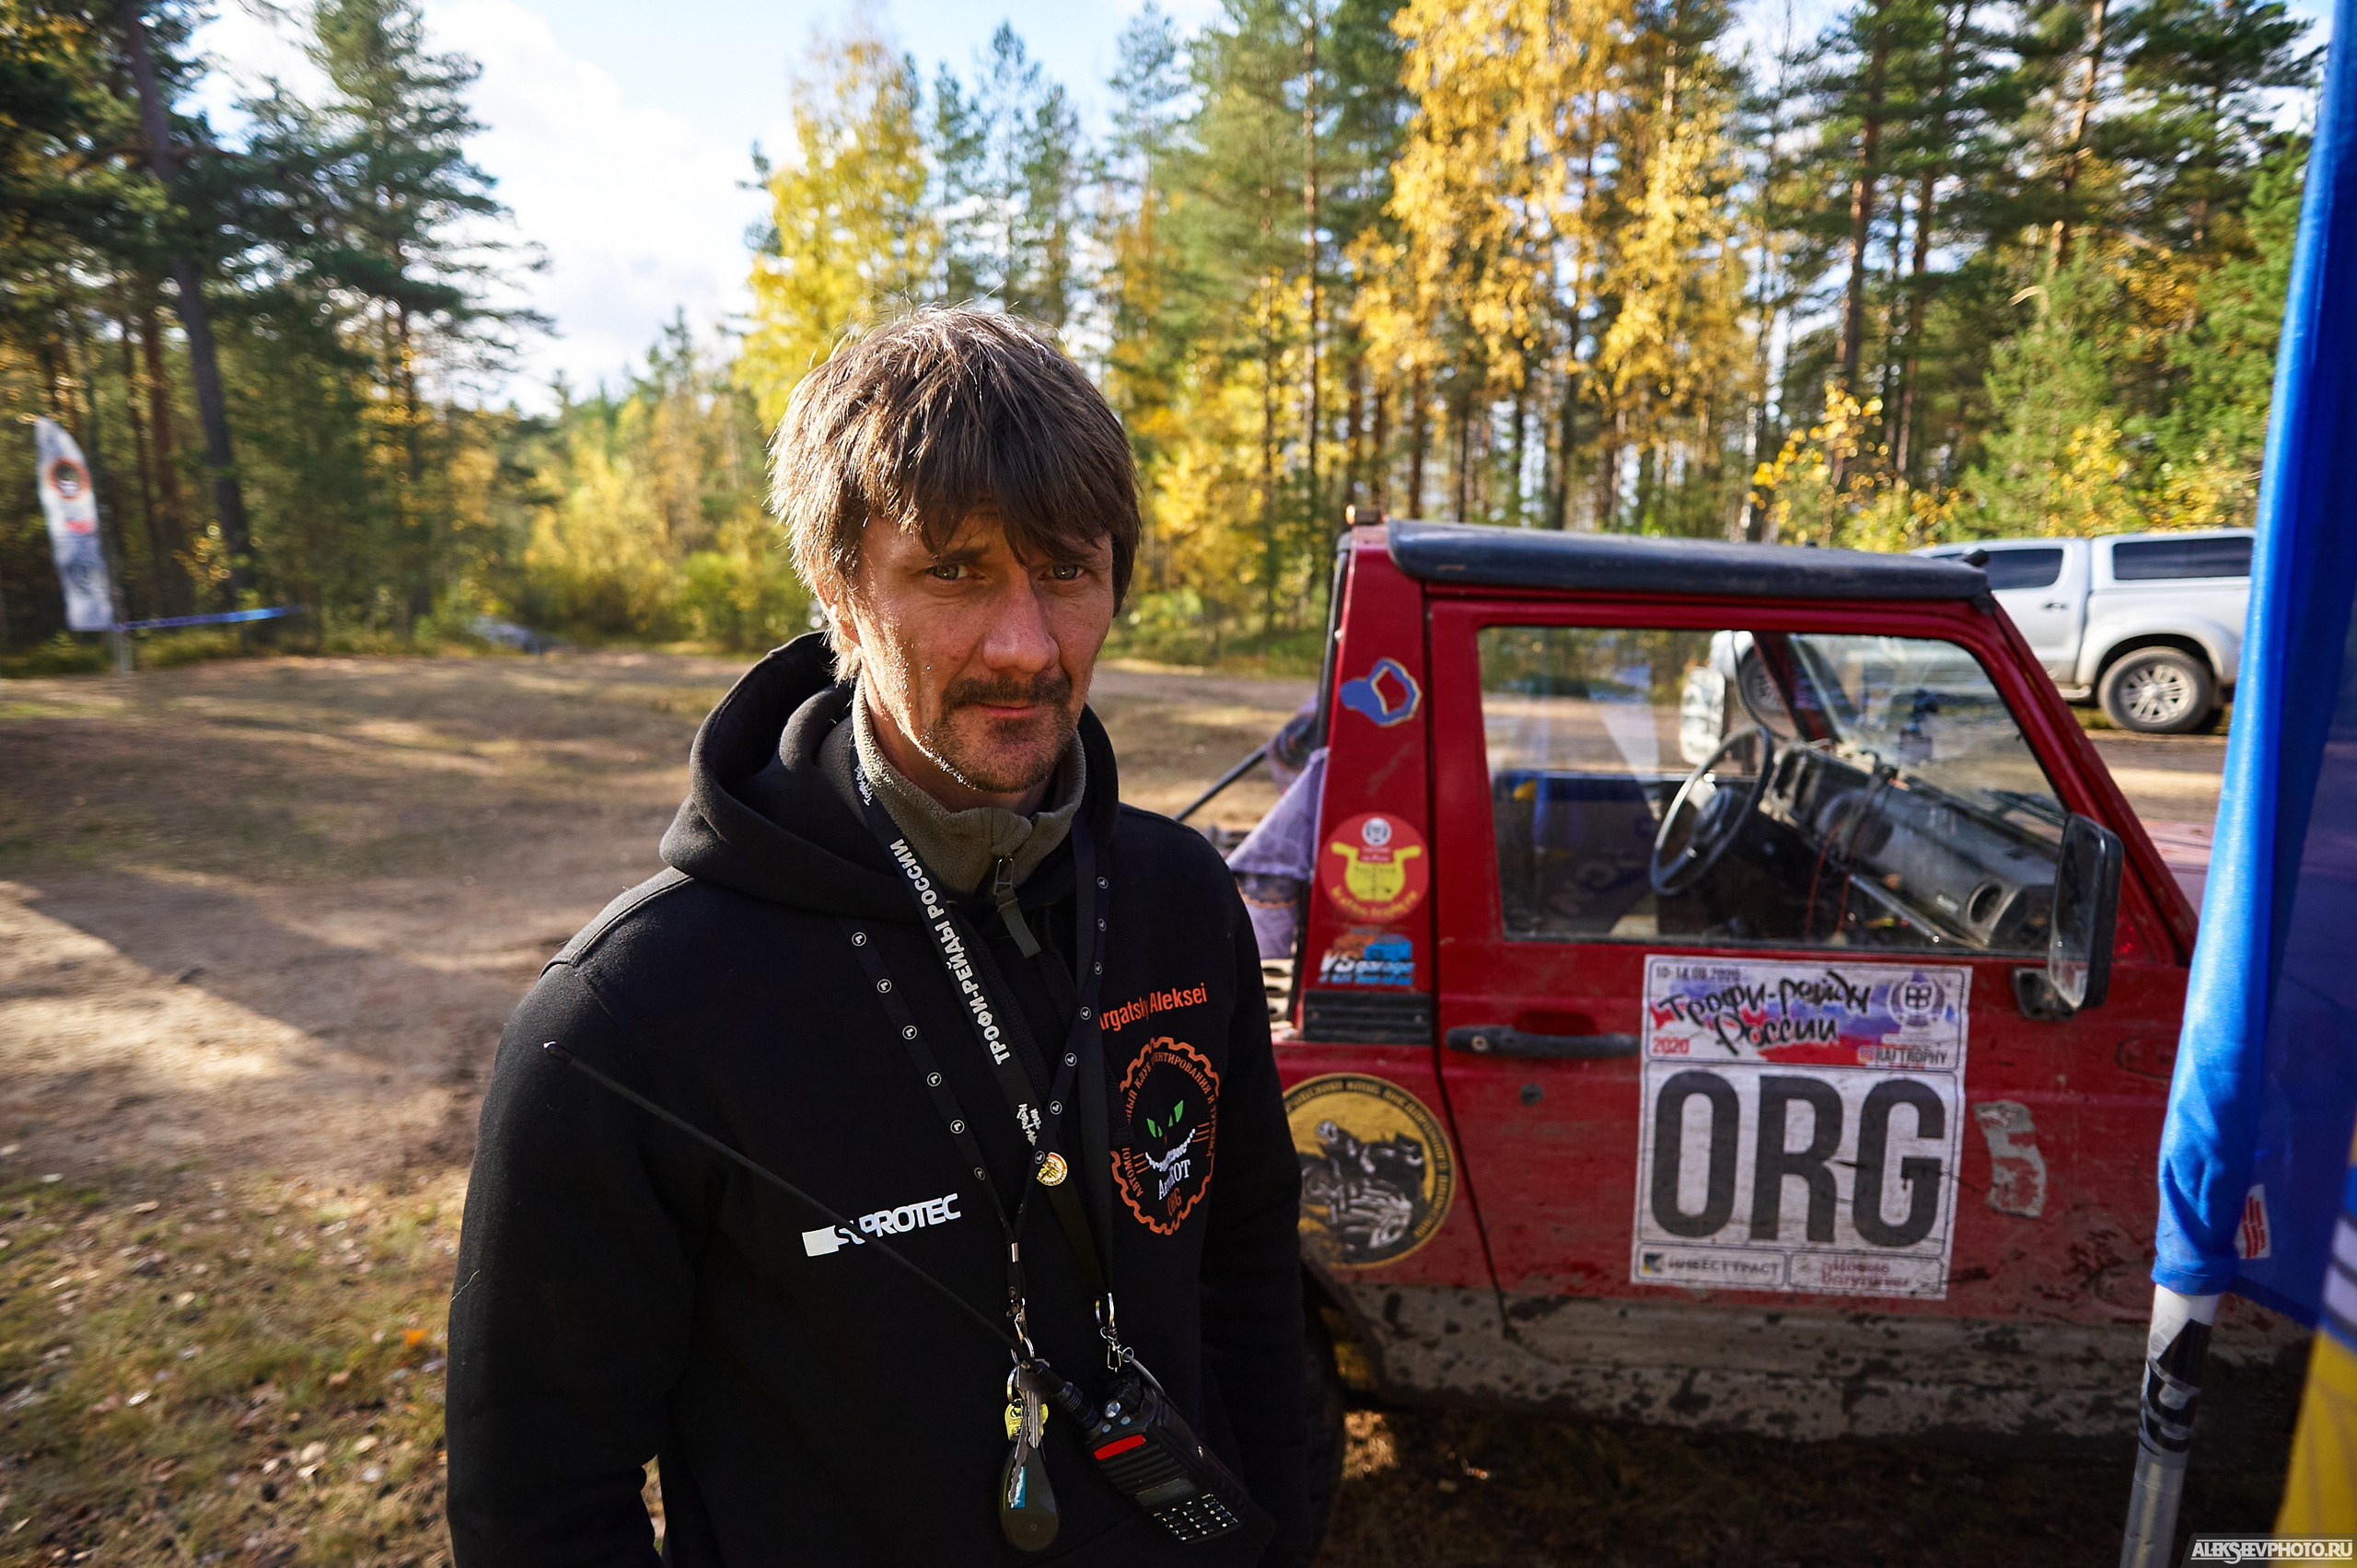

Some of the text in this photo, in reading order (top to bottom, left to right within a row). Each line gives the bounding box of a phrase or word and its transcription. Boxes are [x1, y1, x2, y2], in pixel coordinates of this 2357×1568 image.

[889, 839, 1010, 1065] ТРОФИ-РЕЙДЫ РОССИИ
[1149, 981, 1207, 1013] Aleksei
[1653, 1037, 1689, 1055] 2020
[1651, 1070, 1946, 1248] ORG
